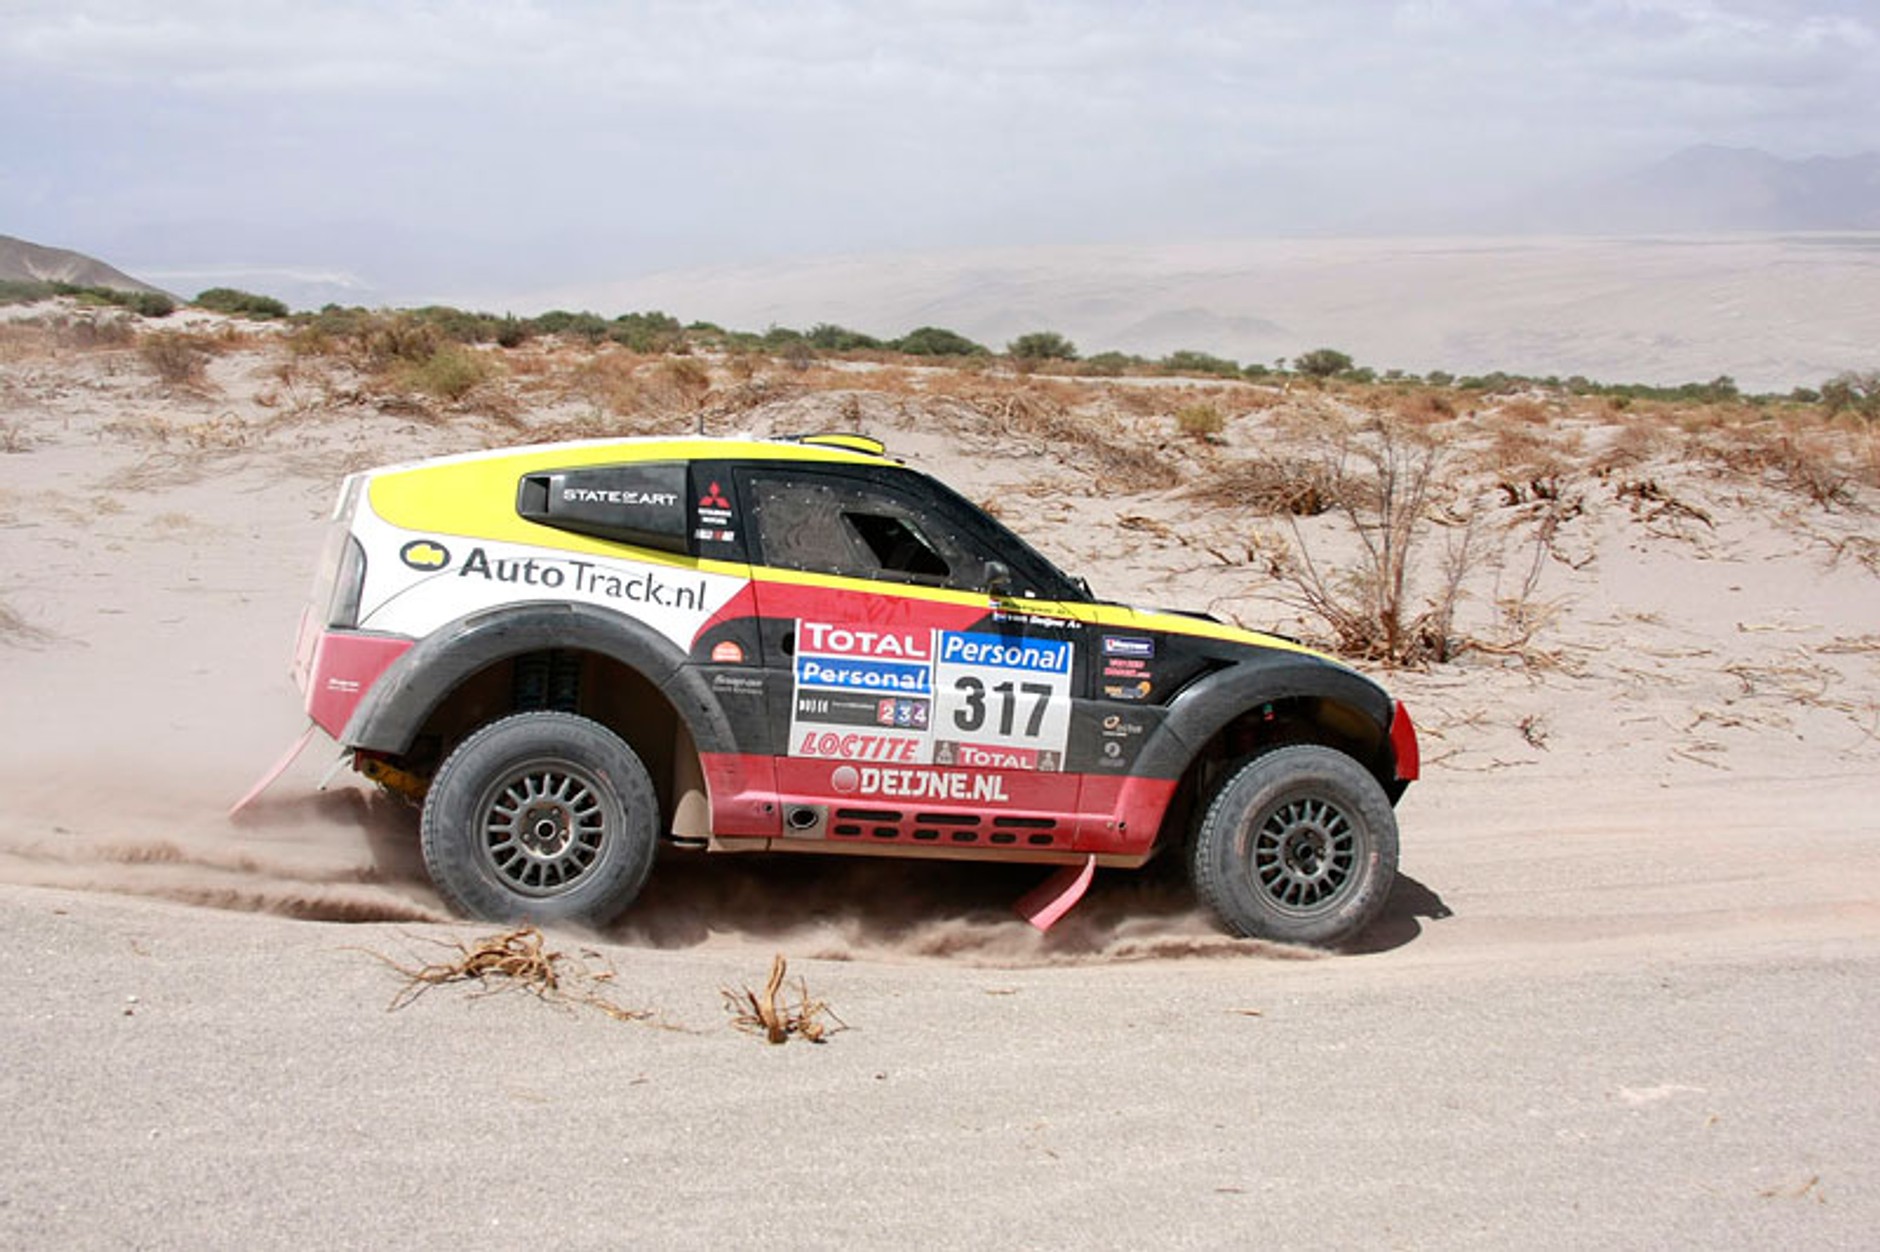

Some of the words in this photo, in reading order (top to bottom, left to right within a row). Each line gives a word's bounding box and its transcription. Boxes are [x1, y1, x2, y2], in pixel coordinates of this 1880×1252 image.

[563, 488, 621, 502] STATE
[639, 492, 678, 506] ART
[458, 547, 707, 611] AutoTrack.nl
[945, 636, 1066, 670] Personal
[803, 662, 926, 689] Personal
[954, 676, 1053, 737] 317
[800, 731, 920, 761] LOCTITE
[860, 768, 1008, 802] DEIJNE.NL
